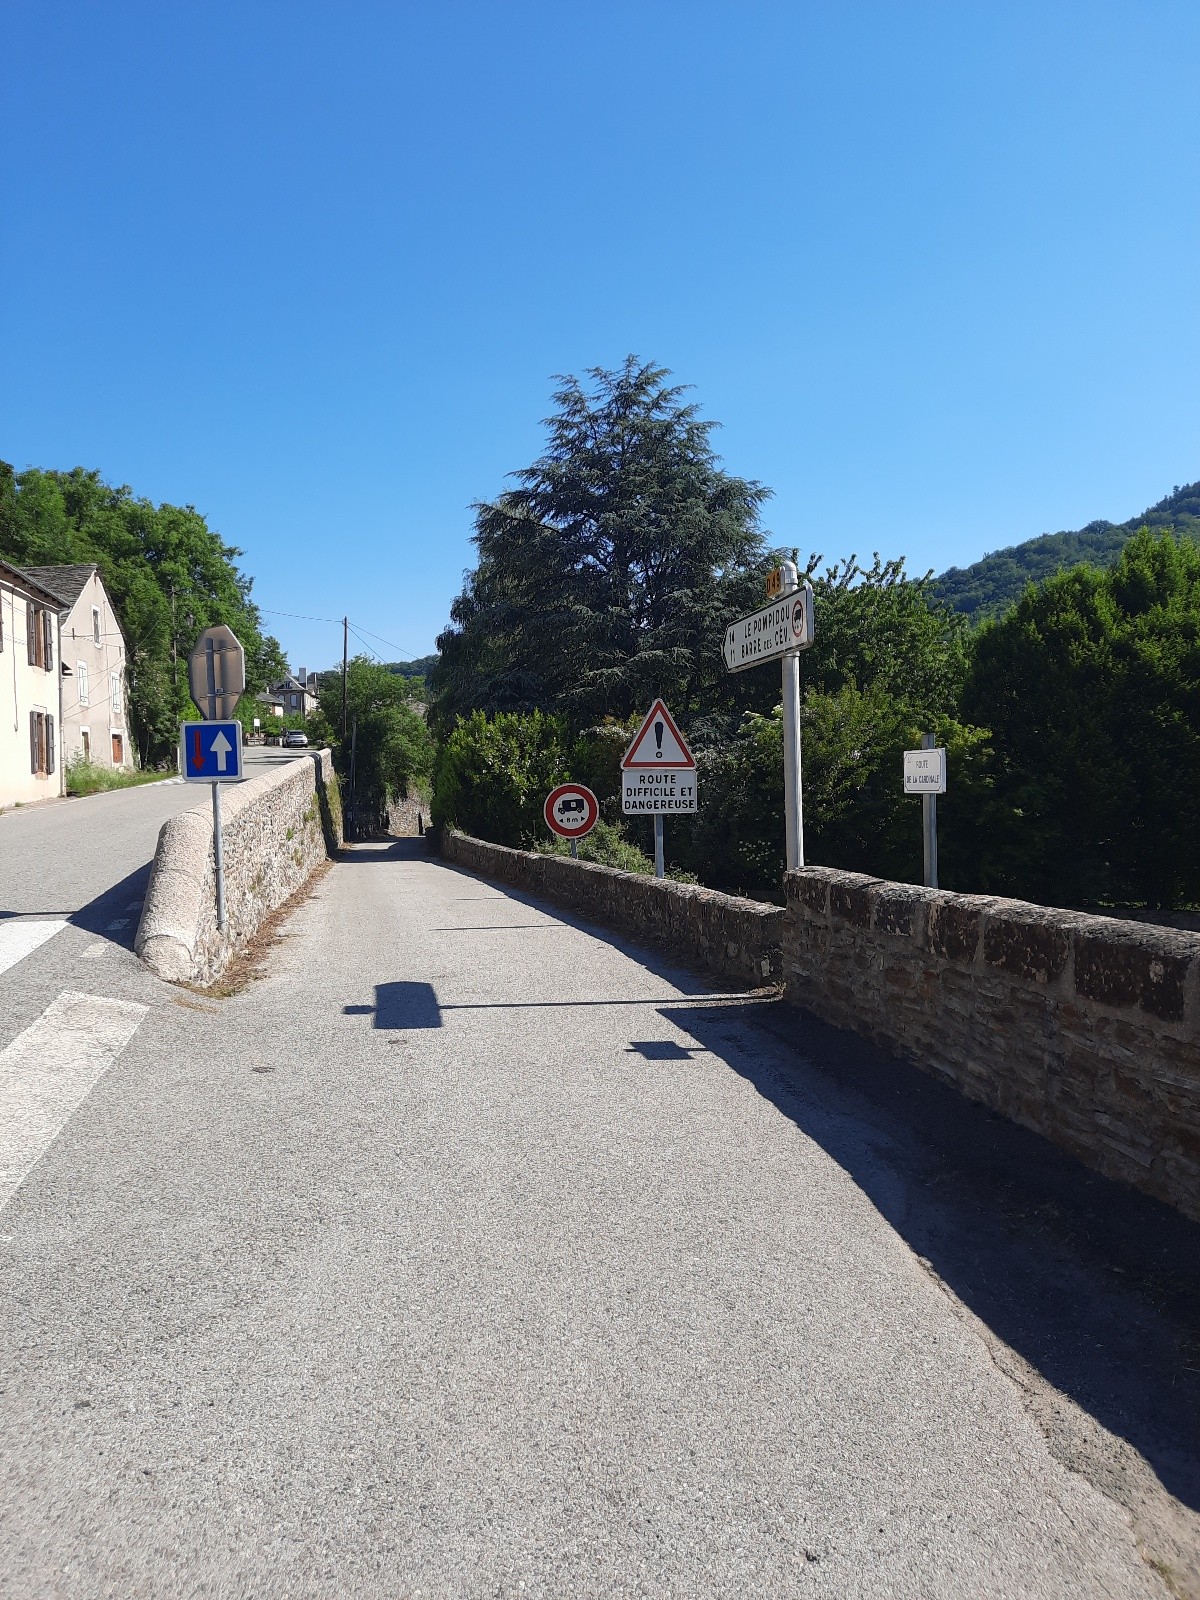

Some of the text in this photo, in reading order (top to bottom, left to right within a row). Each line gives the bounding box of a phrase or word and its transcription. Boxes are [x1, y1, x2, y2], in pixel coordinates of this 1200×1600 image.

[729, 604, 789, 645] 14 LE POMPIDOU
[742, 640, 761, 658] BARRE
[775, 626, 790, 645] CÉV.
[916, 760, 928, 769] ROUTE
[640, 775, 676, 784] ROUTE
[627, 788, 692, 796] DIFFICILE ET
[625, 800, 694, 809] DANGEREUSE
